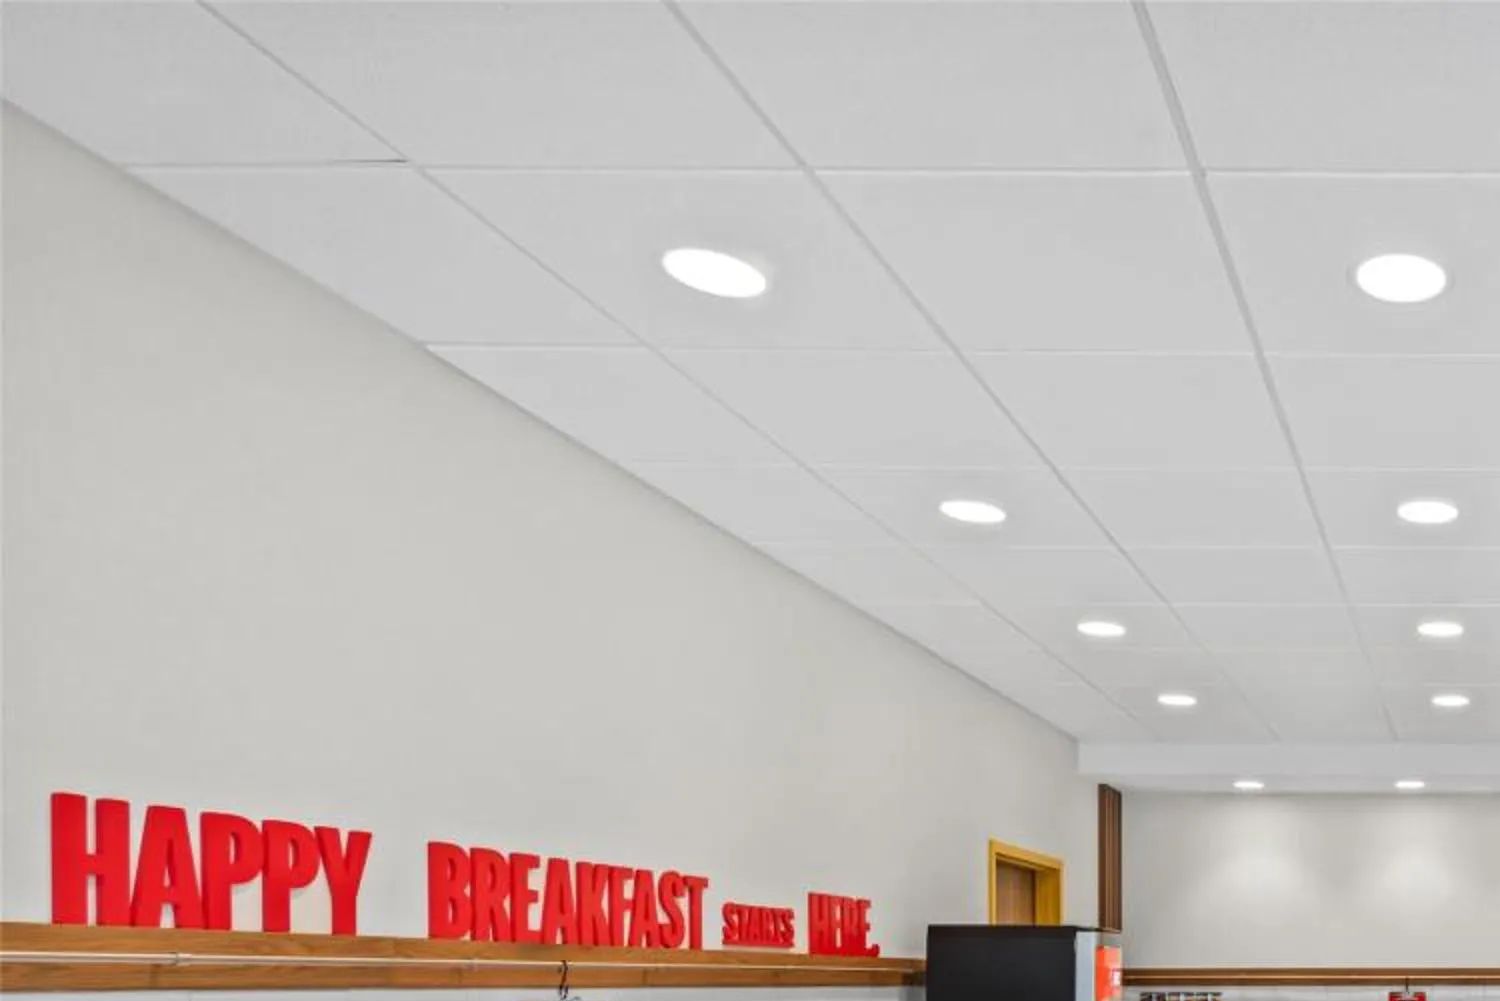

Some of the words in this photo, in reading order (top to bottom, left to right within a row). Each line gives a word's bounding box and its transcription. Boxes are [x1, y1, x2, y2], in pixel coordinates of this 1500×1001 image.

[50, 791, 373, 937] HAPPY
[427, 840, 710, 951] BREAKFAST
[721, 901, 796, 949] STARTS
[807, 891, 881, 957] HERE.
